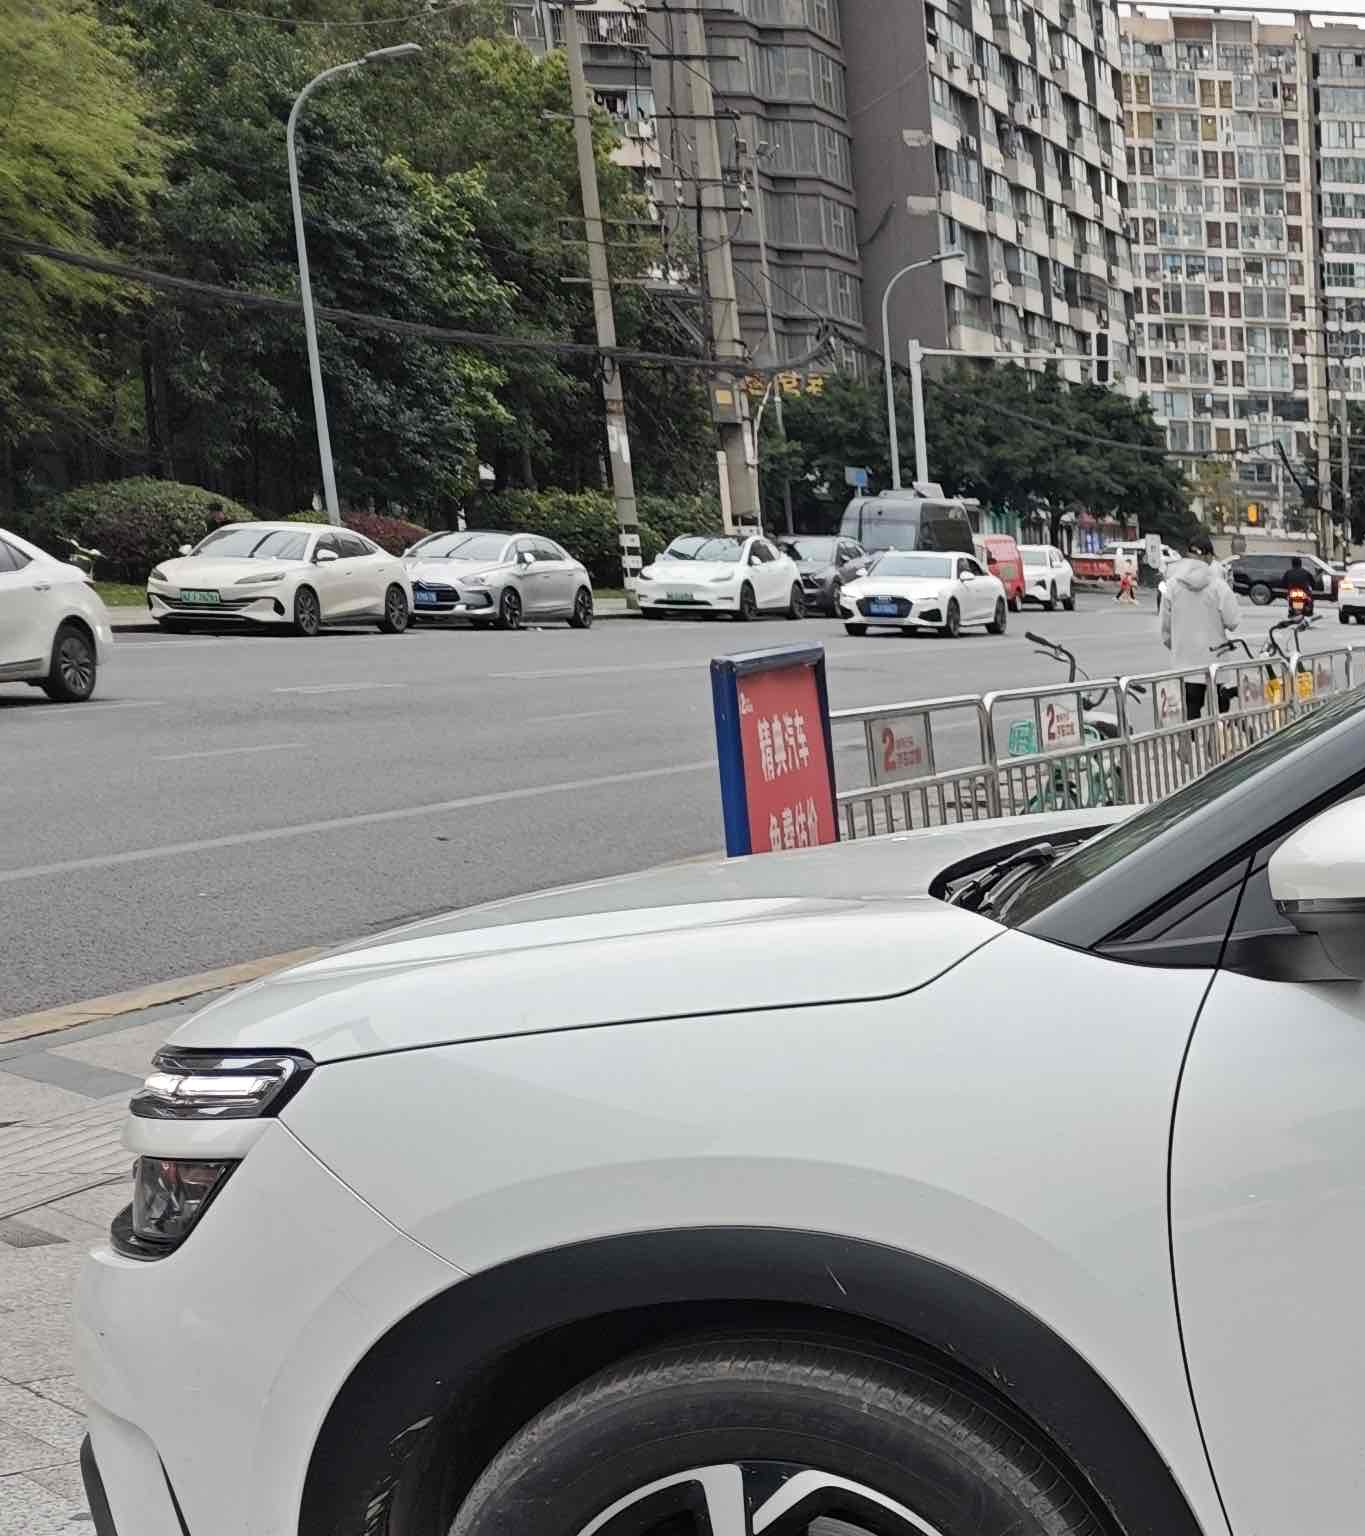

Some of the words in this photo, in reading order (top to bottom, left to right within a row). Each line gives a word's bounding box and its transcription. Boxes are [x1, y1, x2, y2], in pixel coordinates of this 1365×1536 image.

[757, 709, 810, 783] 精典汽车
[881, 727, 897, 770] 2
